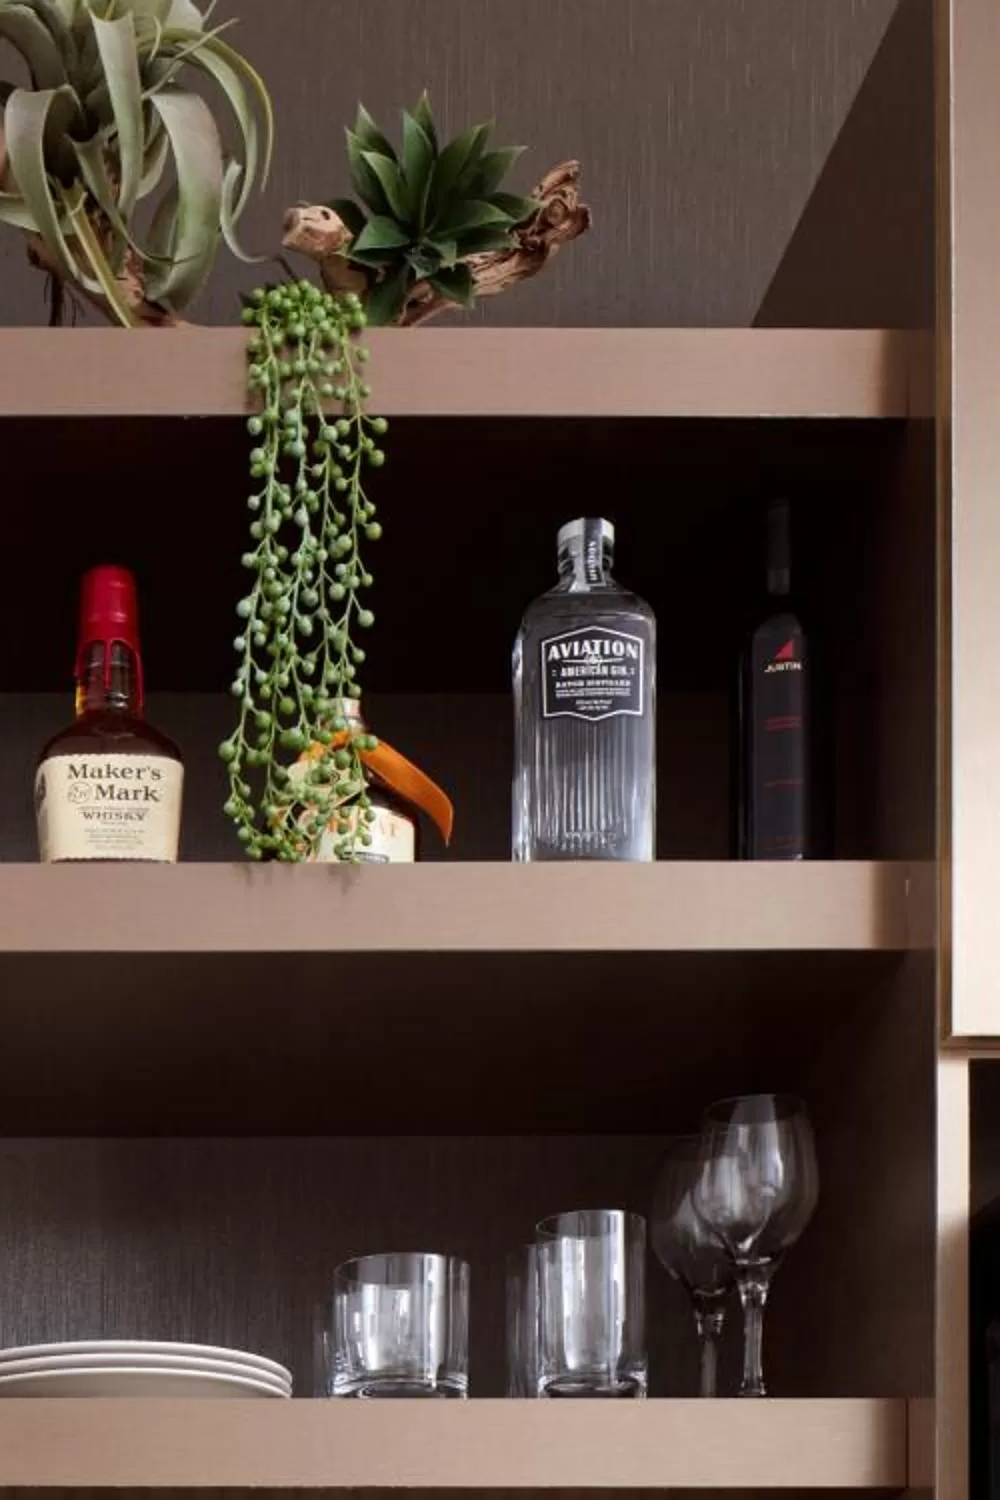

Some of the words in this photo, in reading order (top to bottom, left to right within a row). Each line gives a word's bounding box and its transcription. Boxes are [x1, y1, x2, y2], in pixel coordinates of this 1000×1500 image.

[547, 639, 639, 661] AVIATION
[67, 763, 162, 781] Maker's
[94, 783, 161, 803] Mark
[81, 811, 146, 821] WHISKY
